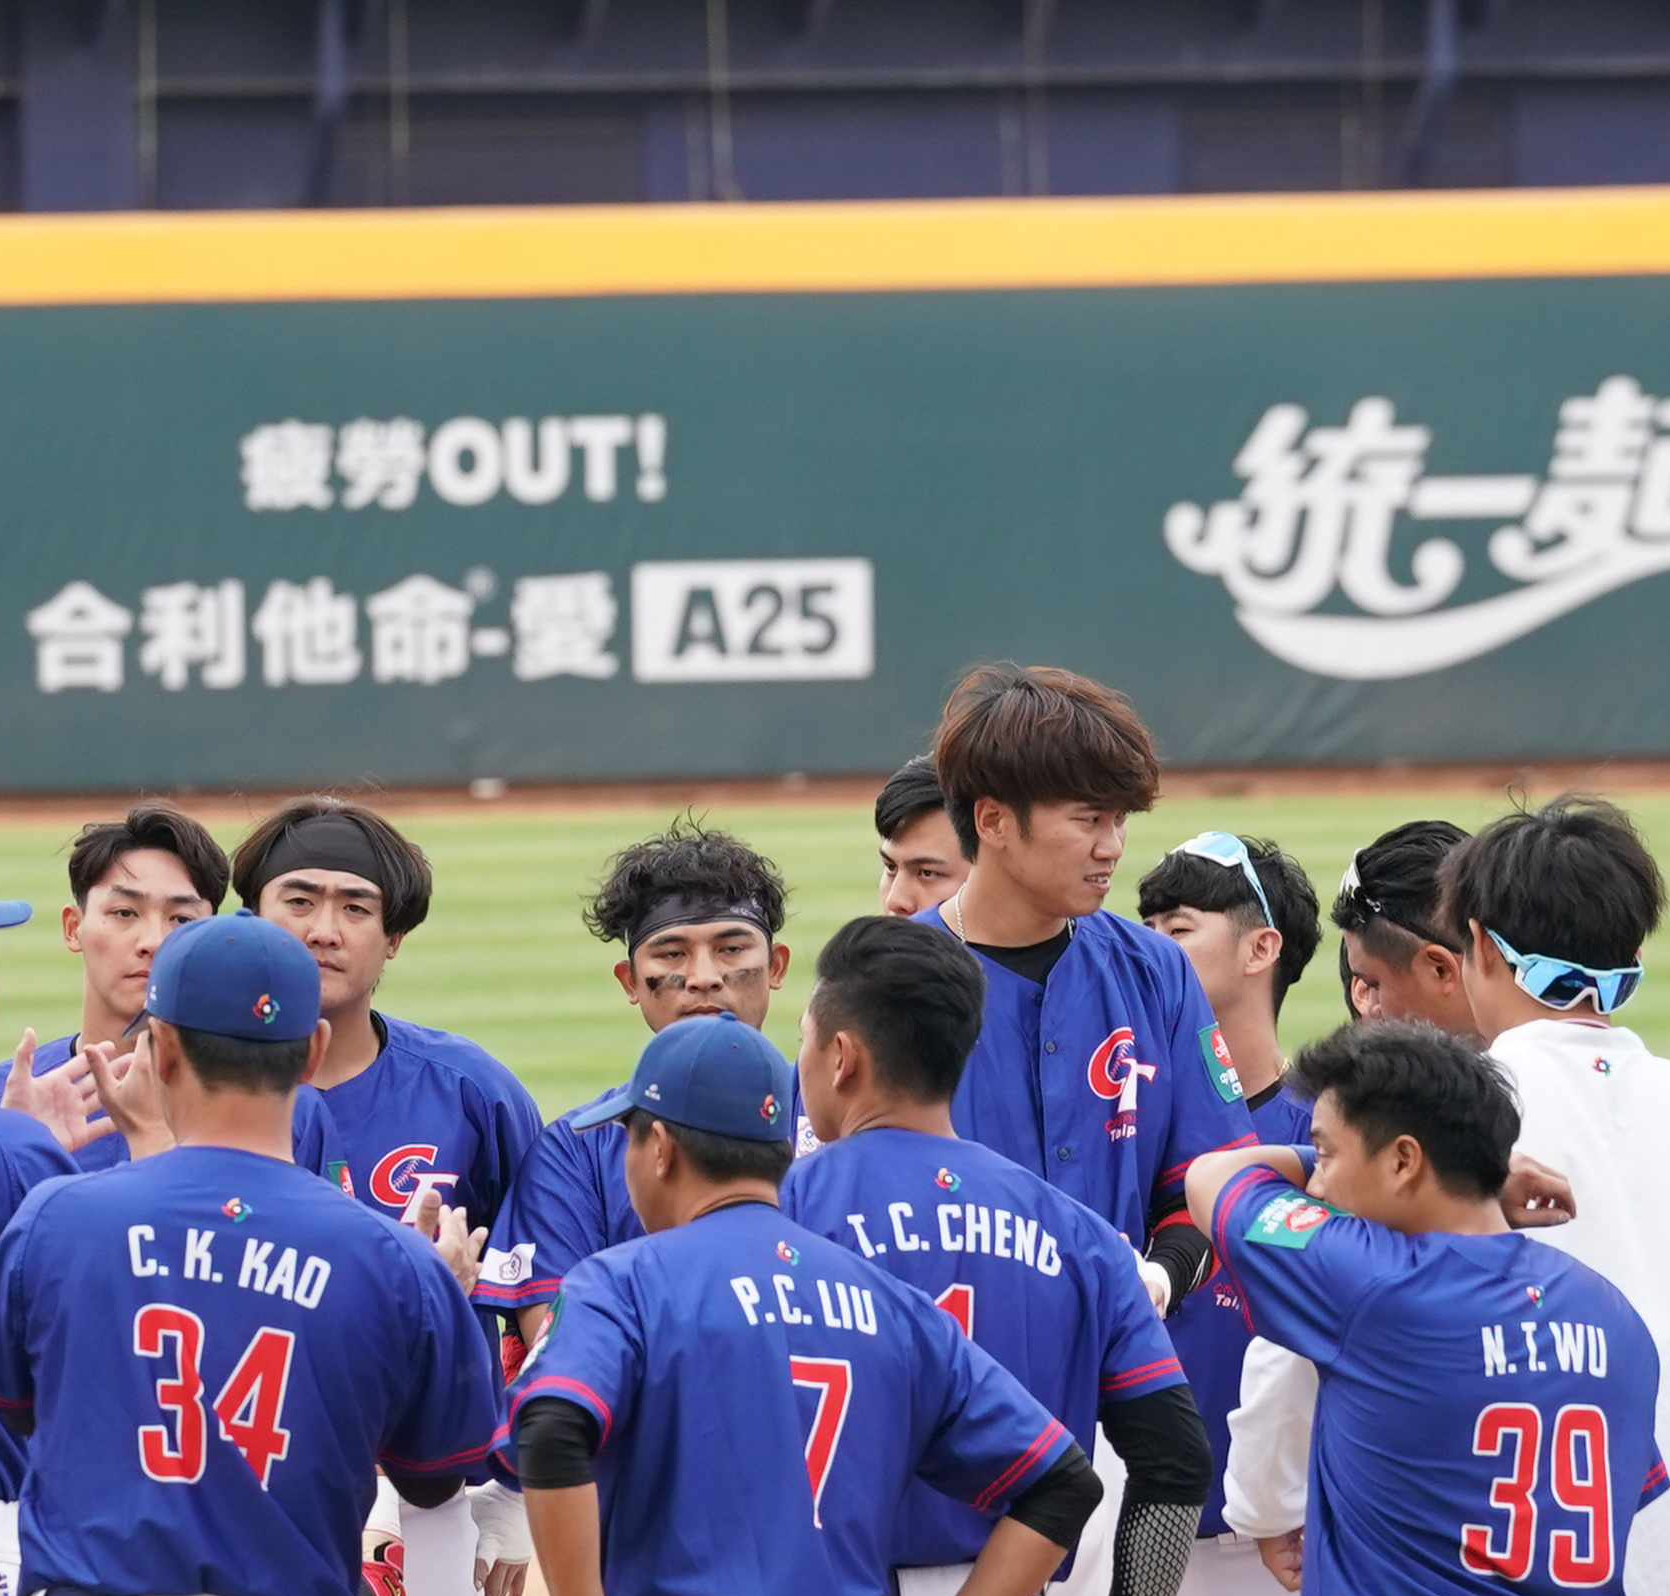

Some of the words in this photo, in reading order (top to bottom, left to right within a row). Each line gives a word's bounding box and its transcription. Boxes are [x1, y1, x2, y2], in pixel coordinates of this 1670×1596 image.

[670, 582, 840, 657] A25
[126, 1224, 169, 1278] C.
[184, 1228, 224, 1285] K.
[238, 1237, 331, 1310] KAO
[846, 1212, 887, 1258] T.
[887, 1202, 931, 1253] C.
[730, 1275, 776, 1327] P.
[778, 1273, 814, 1326] C.
[815, 1279, 878, 1337] LIU
[1481, 1325, 1518, 1378] N.
[1521, 1320, 1548, 1373] T.
[1549, 1320, 1609, 1379] WU
[133, 1302, 296, 1492] 34
[789, 1354, 854, 1531] 7
[1459, 1401, 1617, 1589] 39
